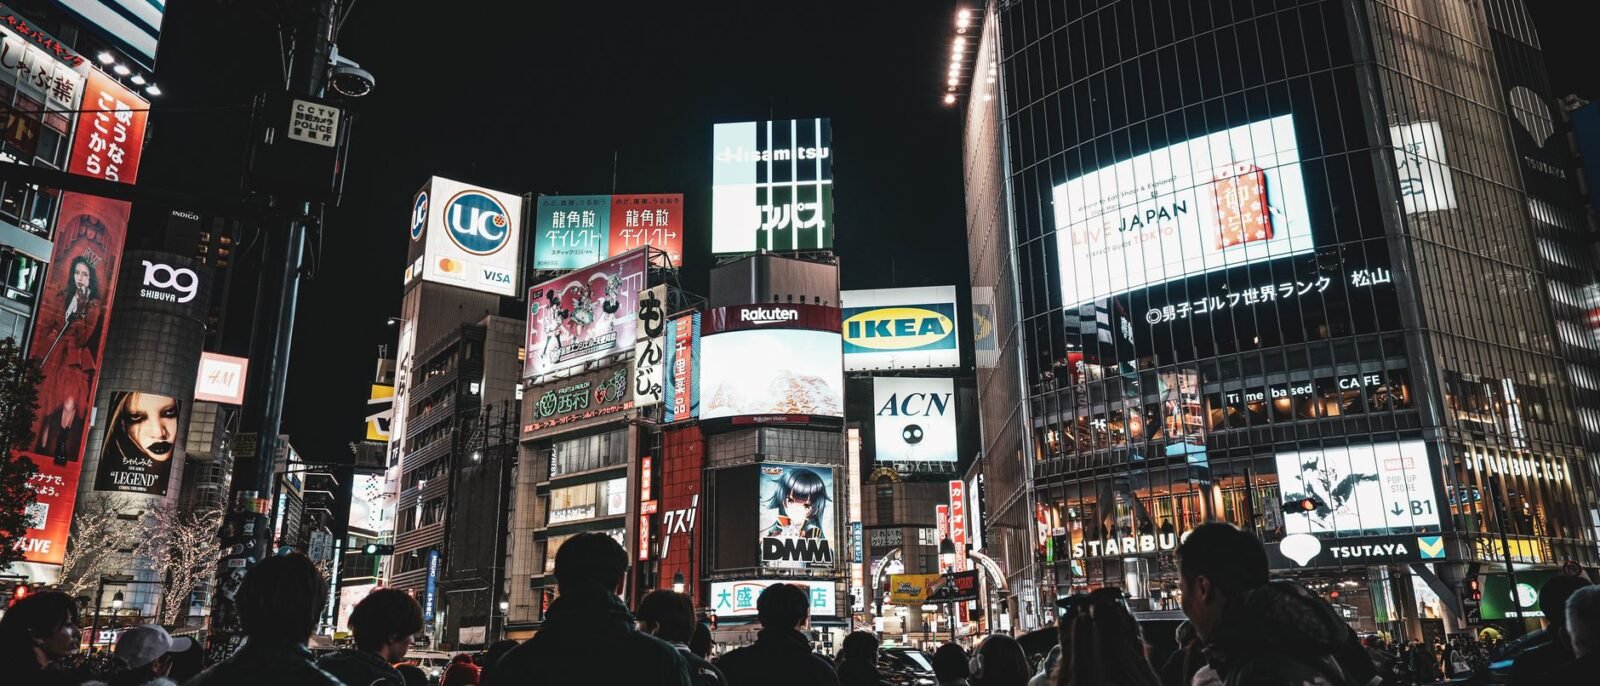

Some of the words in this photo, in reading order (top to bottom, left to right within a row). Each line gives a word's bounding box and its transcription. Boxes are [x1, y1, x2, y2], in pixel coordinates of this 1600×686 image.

[87, 91, 114, 174] ここから
[294, 120, 333, 134] POLICE
[107, 100, 134, 181] 歌うなら
[172, 210, 199, 221] INDIGO
[552, 210, 595, 229] 龍角散
[626, 209, 669, 227] 龍角散
[1072, 221, 1112, 246] LIVE
[1118, 199, 1187, 232] JAPAN
[545, 229, 602, 248] ダイレクト
[619, 228, 677, 247] ダイレクト
[142, 260, 199, 303] 109
[484, 270, 510, 284] VISA
[1351, 267, 1392, 288] 松山
[140, 288, 176, 302] SHIBUYA
[741, 307, 798, 322] Rakuten
[848, 317, 945, 338] IKEA
[636, 290, 664, 400] もんじゃ
[1339, 374, 1381, 390] CAFE
[557, 389, 590, 414] 西村
[1227, 391, 1264, 404] Time
[1270, 383, 1313, 398] based
[876, 392, 951, 417] ACN
[951, 487, 963, 537] カラオケ
[1410, 499, 1432, 516] B1
[762, 537, 832, 563] DMM
[1330, 543, 1408, 559] TSUTAYA
